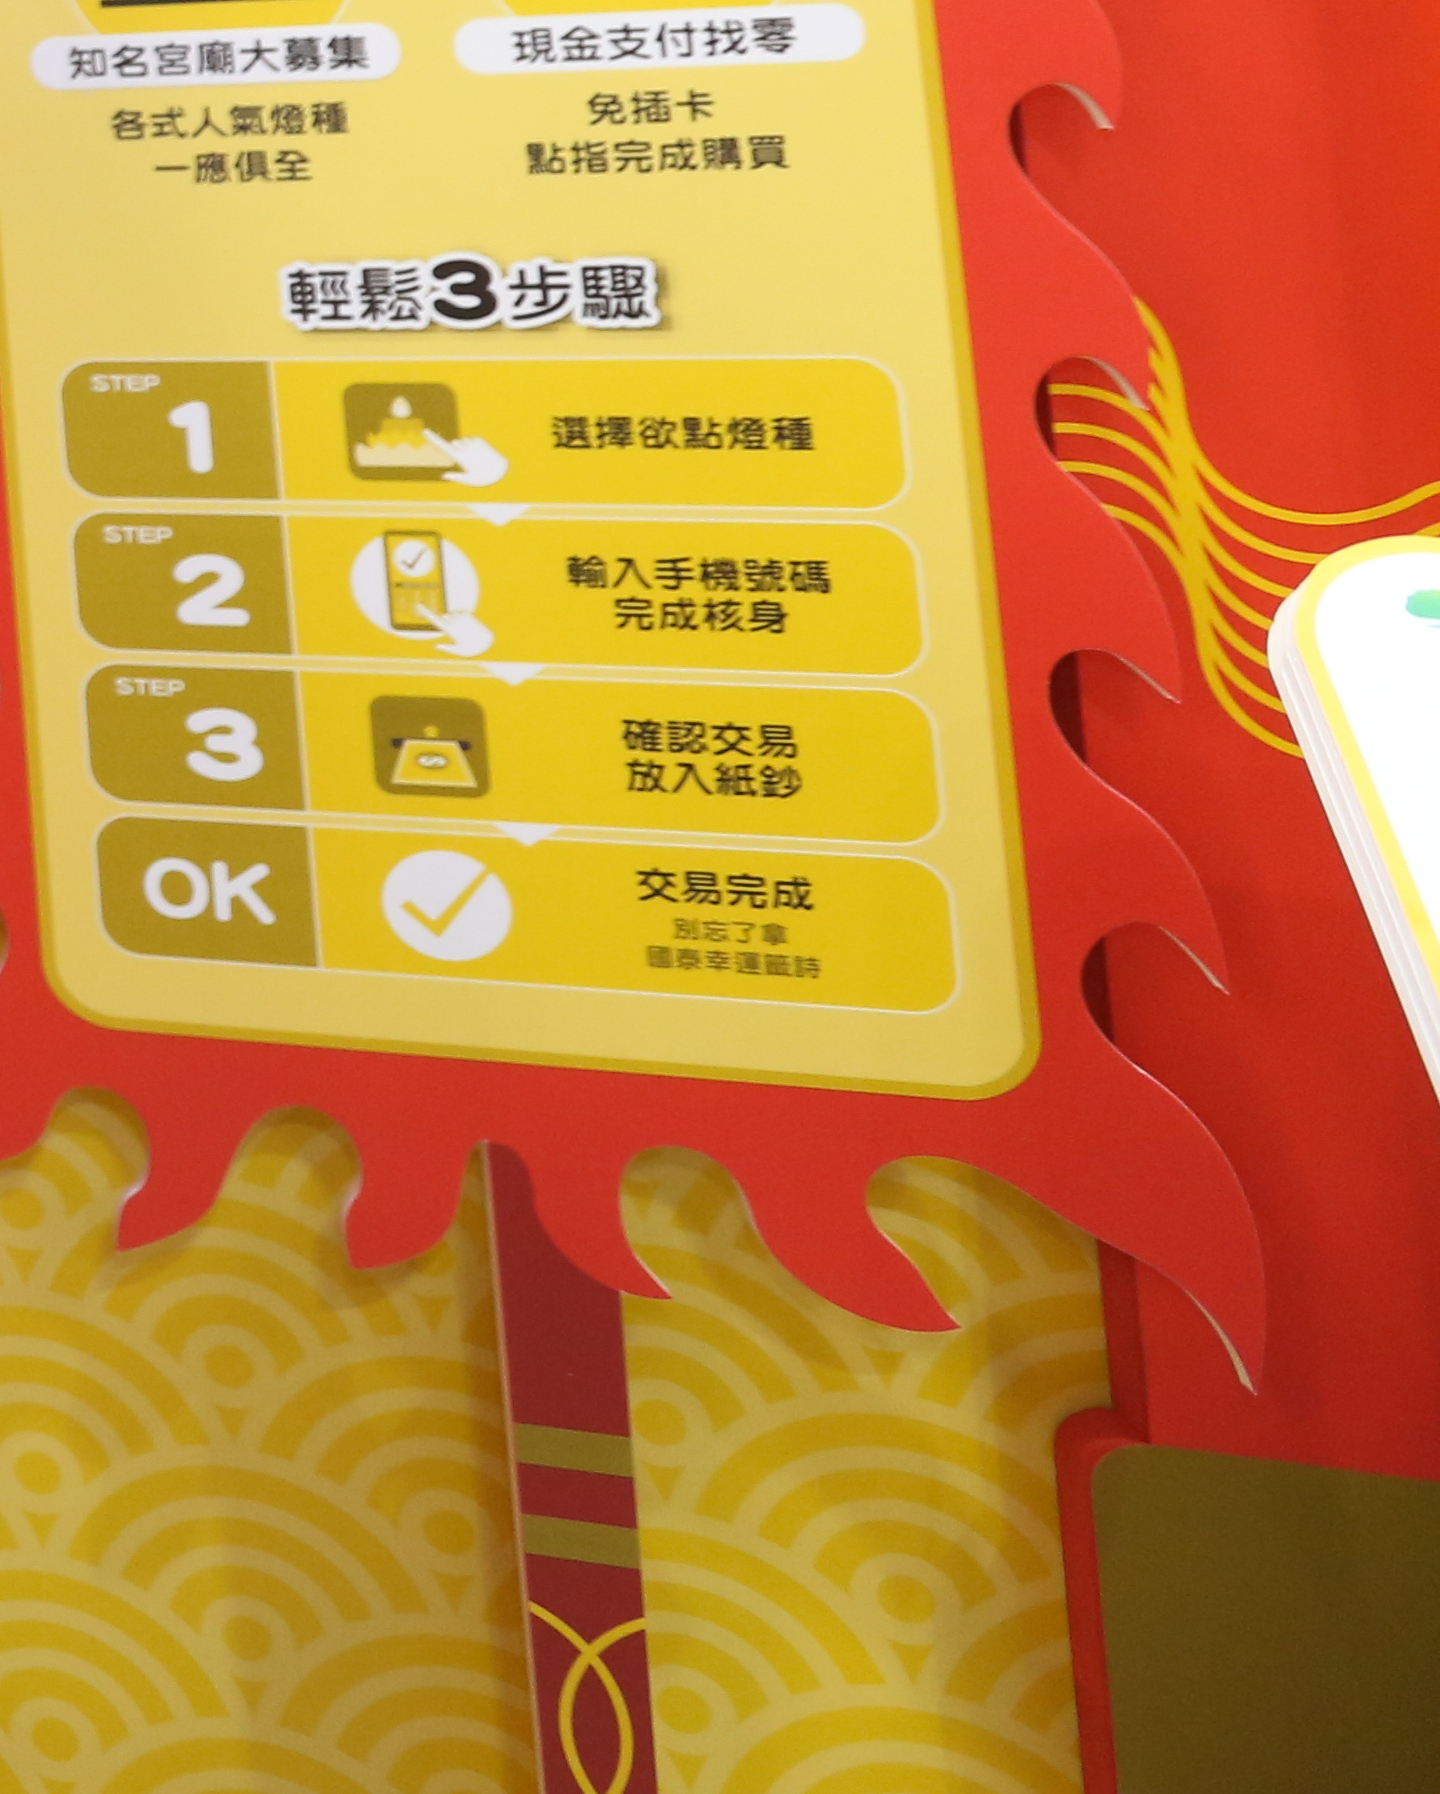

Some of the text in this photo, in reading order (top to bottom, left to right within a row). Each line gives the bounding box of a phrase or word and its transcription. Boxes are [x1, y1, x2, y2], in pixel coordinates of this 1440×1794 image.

[69, 34, 370, 79] 知名宮廟大募集
[512, 17, 799, 64] 現金支付找零
[112, 101, 348, 141] 各式人氣燈種
[587, 91, 714, 126] 免插卡
[155, 149, 313, 185] 一應俱全
[527, 135, 789, 175] 點指完成購買
[286, 257, 657, 323] 輕鬆3步驟
[91, 374, 160, 392] STEP
[167, 400, 214, 474] 1
[552, 416, 814, 453] 選擇欲點燈種
[103, 526, 173, 544] STEP
[173, 554, 250, 627] 2
[567, 555, 832, 594] 輸入手機號碼
[614, 596, 789, 633] 完成核身
[114, 678, 185, 698] STEP
[185, 708, 265, 781] 3
[622, 719, 798, 759] 確認交易
[626, 761, 802, 800] 放入紙鈔
[143, 858, 276, 926] OK
[637, 869, 813, 911] 交易完成
